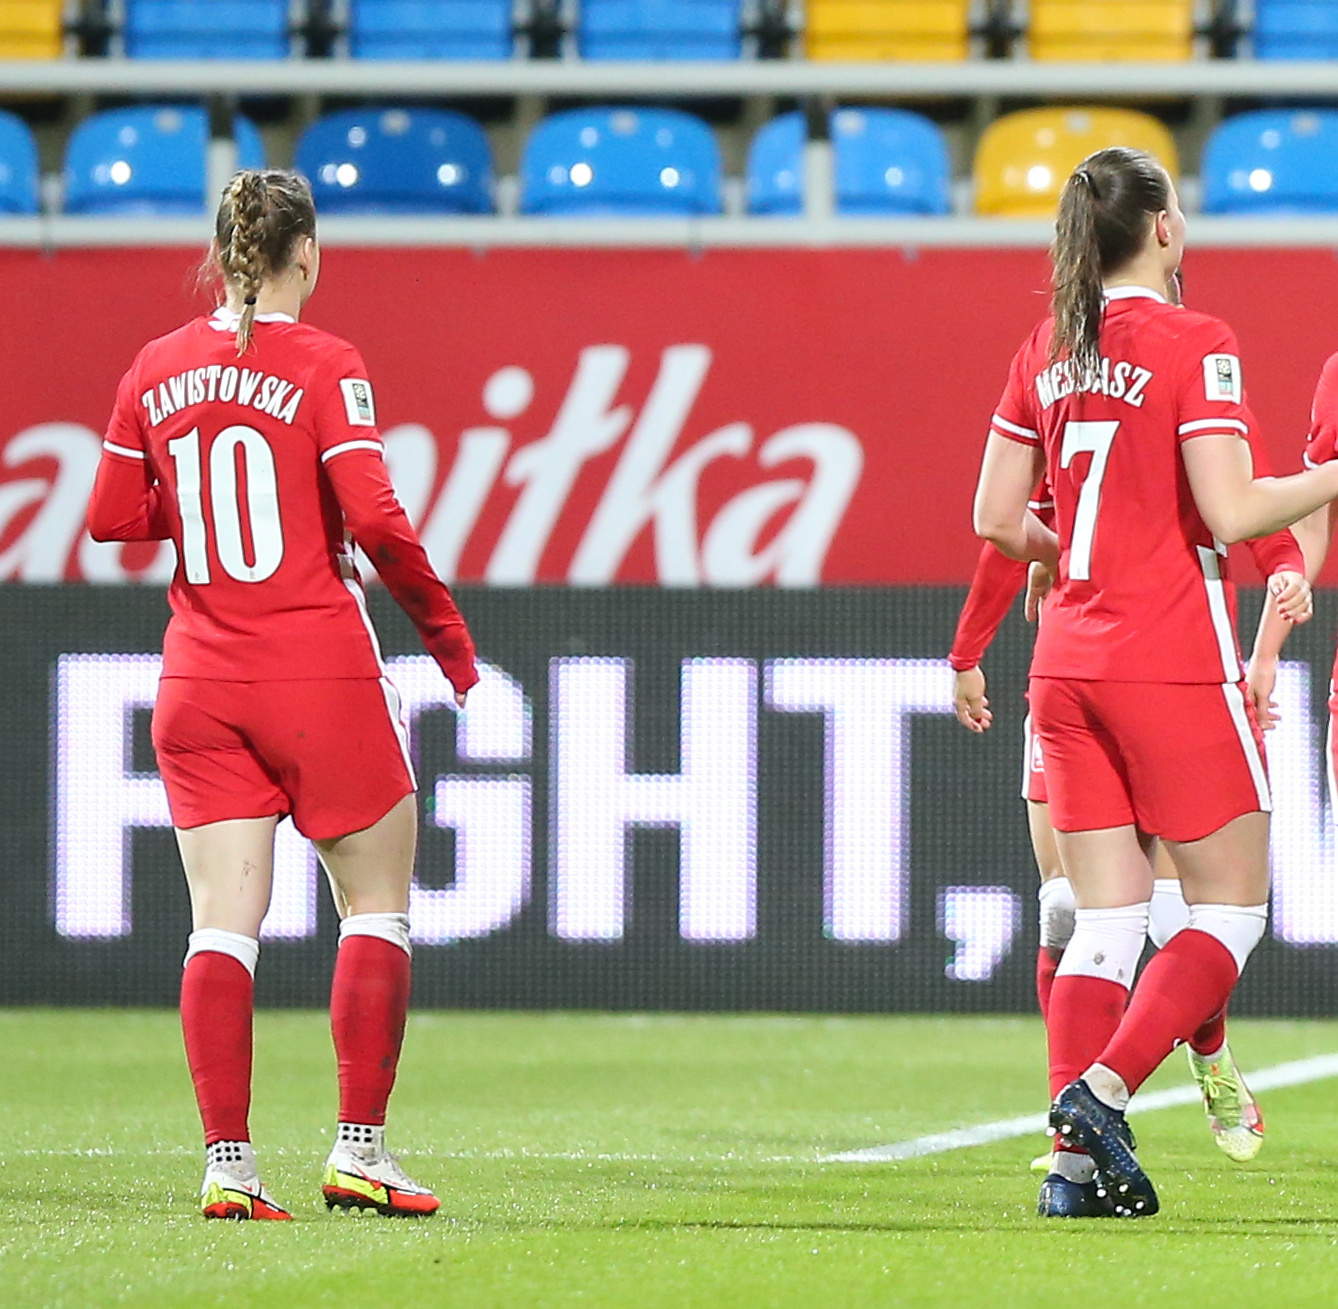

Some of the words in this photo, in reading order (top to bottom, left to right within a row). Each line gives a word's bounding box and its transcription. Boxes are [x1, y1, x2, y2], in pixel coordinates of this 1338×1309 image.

[141, 365, 304, 427] ZAWISTOWSKA
[168, 425, 285, 585] 10
[1060, 420, 1121, 580] 7
[52, 652, 1018, 981] FGHT,
